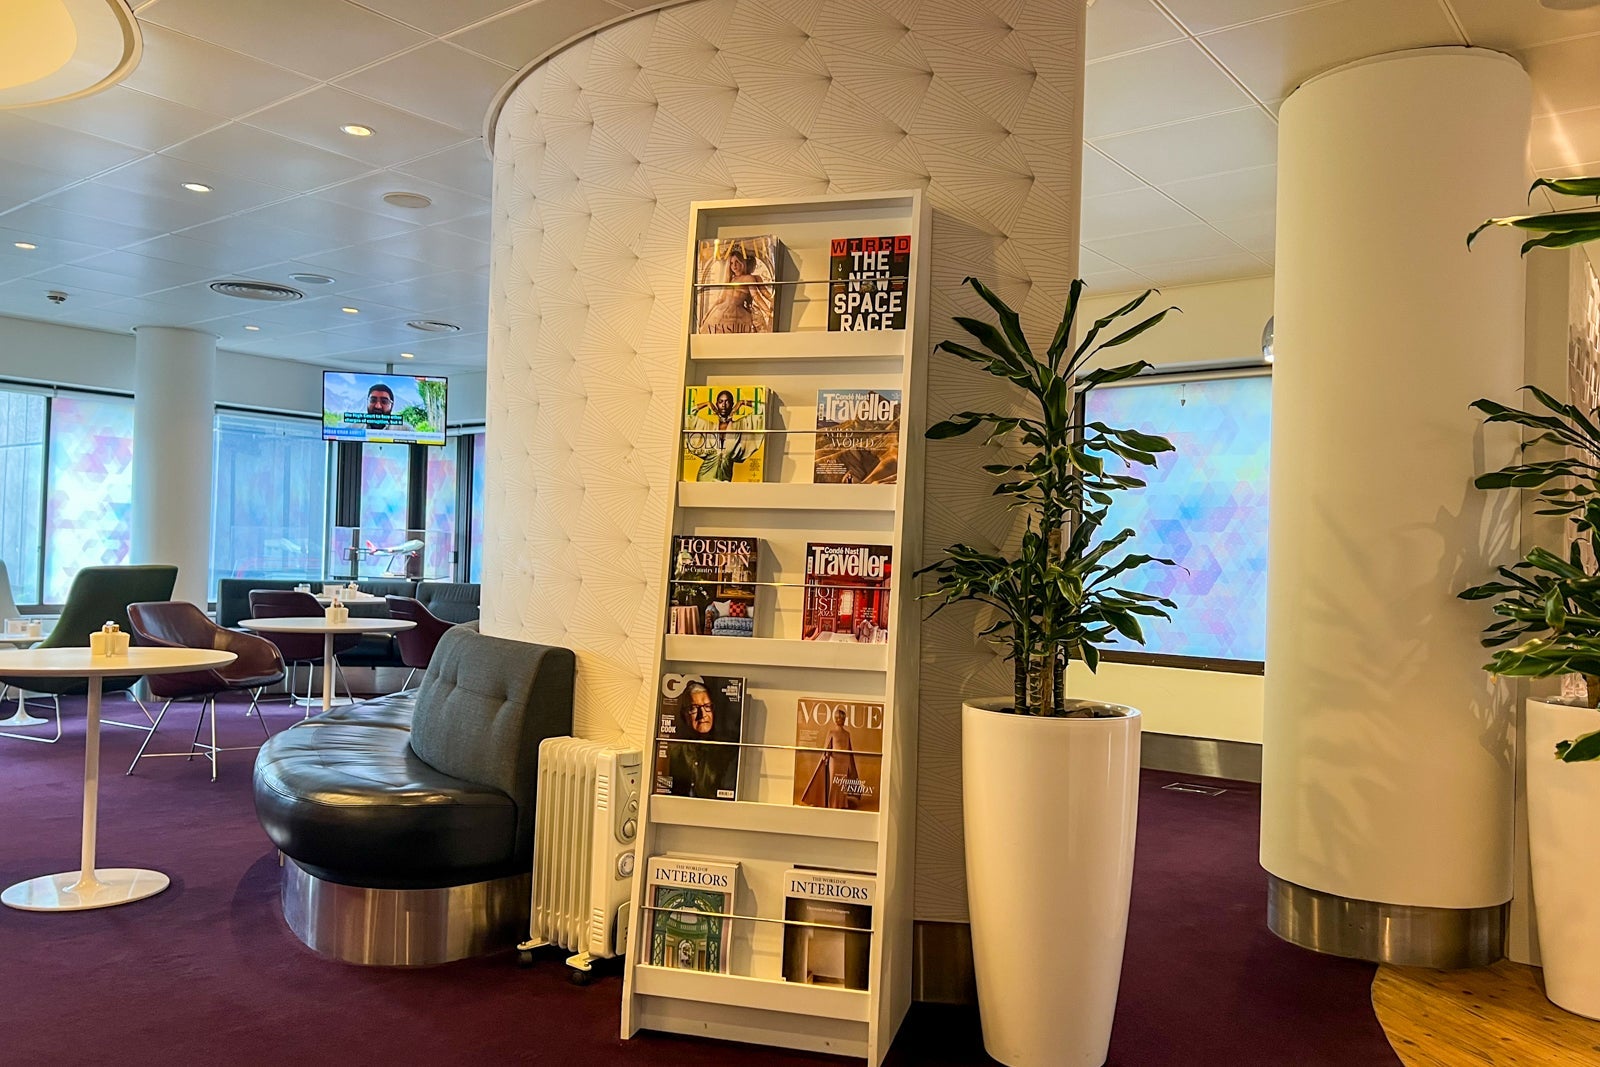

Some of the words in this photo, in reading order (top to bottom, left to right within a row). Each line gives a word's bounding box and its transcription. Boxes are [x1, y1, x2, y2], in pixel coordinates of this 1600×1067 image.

[832, 238, 909, 254] WIRED
[851, 251, 889, 271] THE
[834, 291, 903, 314] SPACE
[840, 313, 894, 331] RACE
[823, 393, 899, 421] Traveller
[831, 437, 874, 448] WORLD
[824, 546, 843, 555] Condé
[690, 552, 750, 568] ARDEN
[811, 546, 888, 577] Traveller
[807, 595, 837, 611] LIST
[661, 719, 671, 727] TIM
[800, 702, 882, 729] VOGUE
[660, 726, 676, 734] COOK
[655, 868, 728, 887] INTERIORS
[791, 880, 868, 900] INTERIORS
